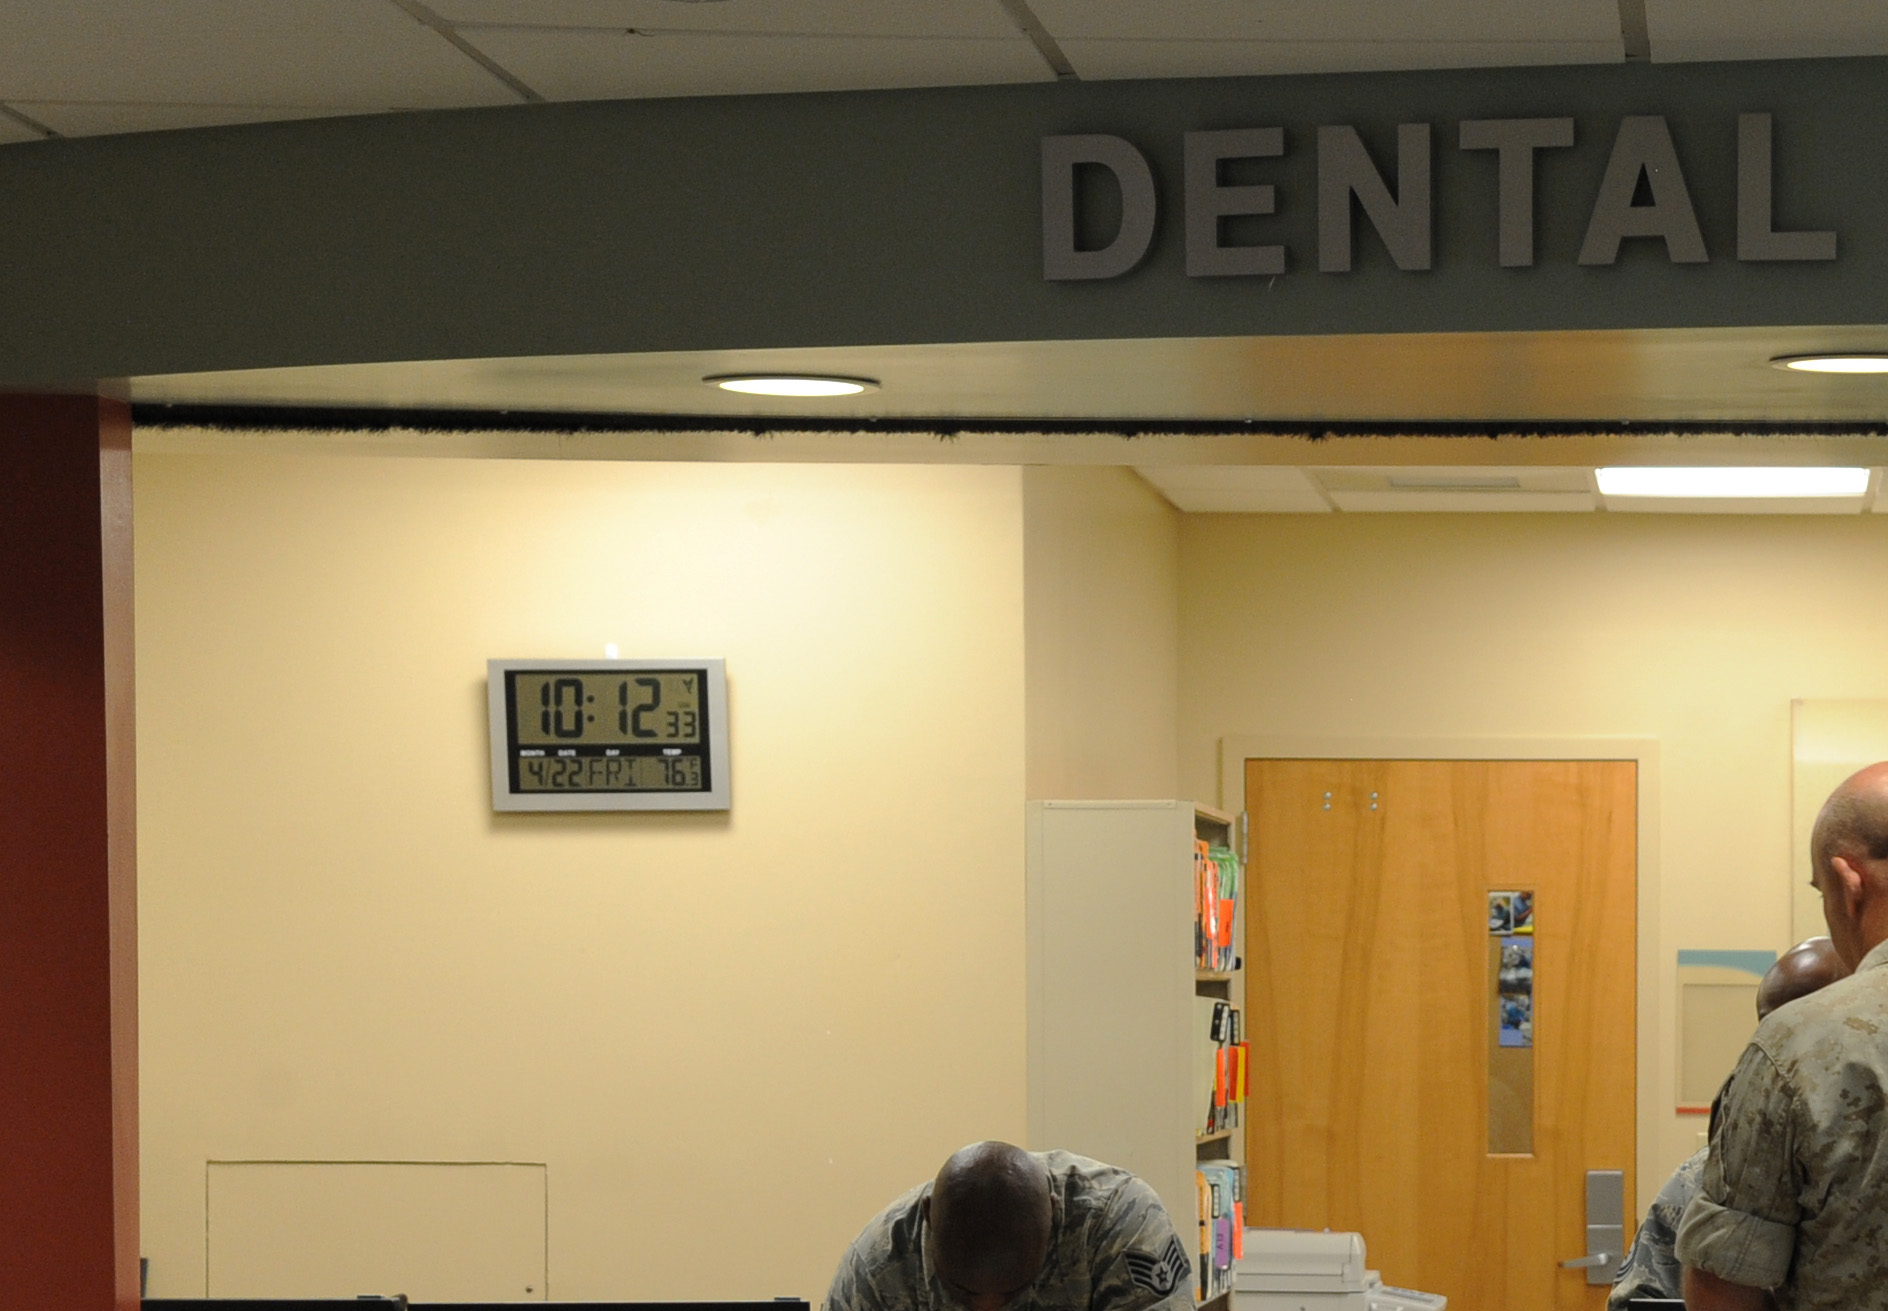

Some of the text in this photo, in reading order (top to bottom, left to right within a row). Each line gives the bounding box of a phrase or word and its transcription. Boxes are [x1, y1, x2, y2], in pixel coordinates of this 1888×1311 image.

[1041, 113, 1838, 280] DENTAL
[557, 749, 577, 757] DATE
[662, 748, 682, 756] TEMP
